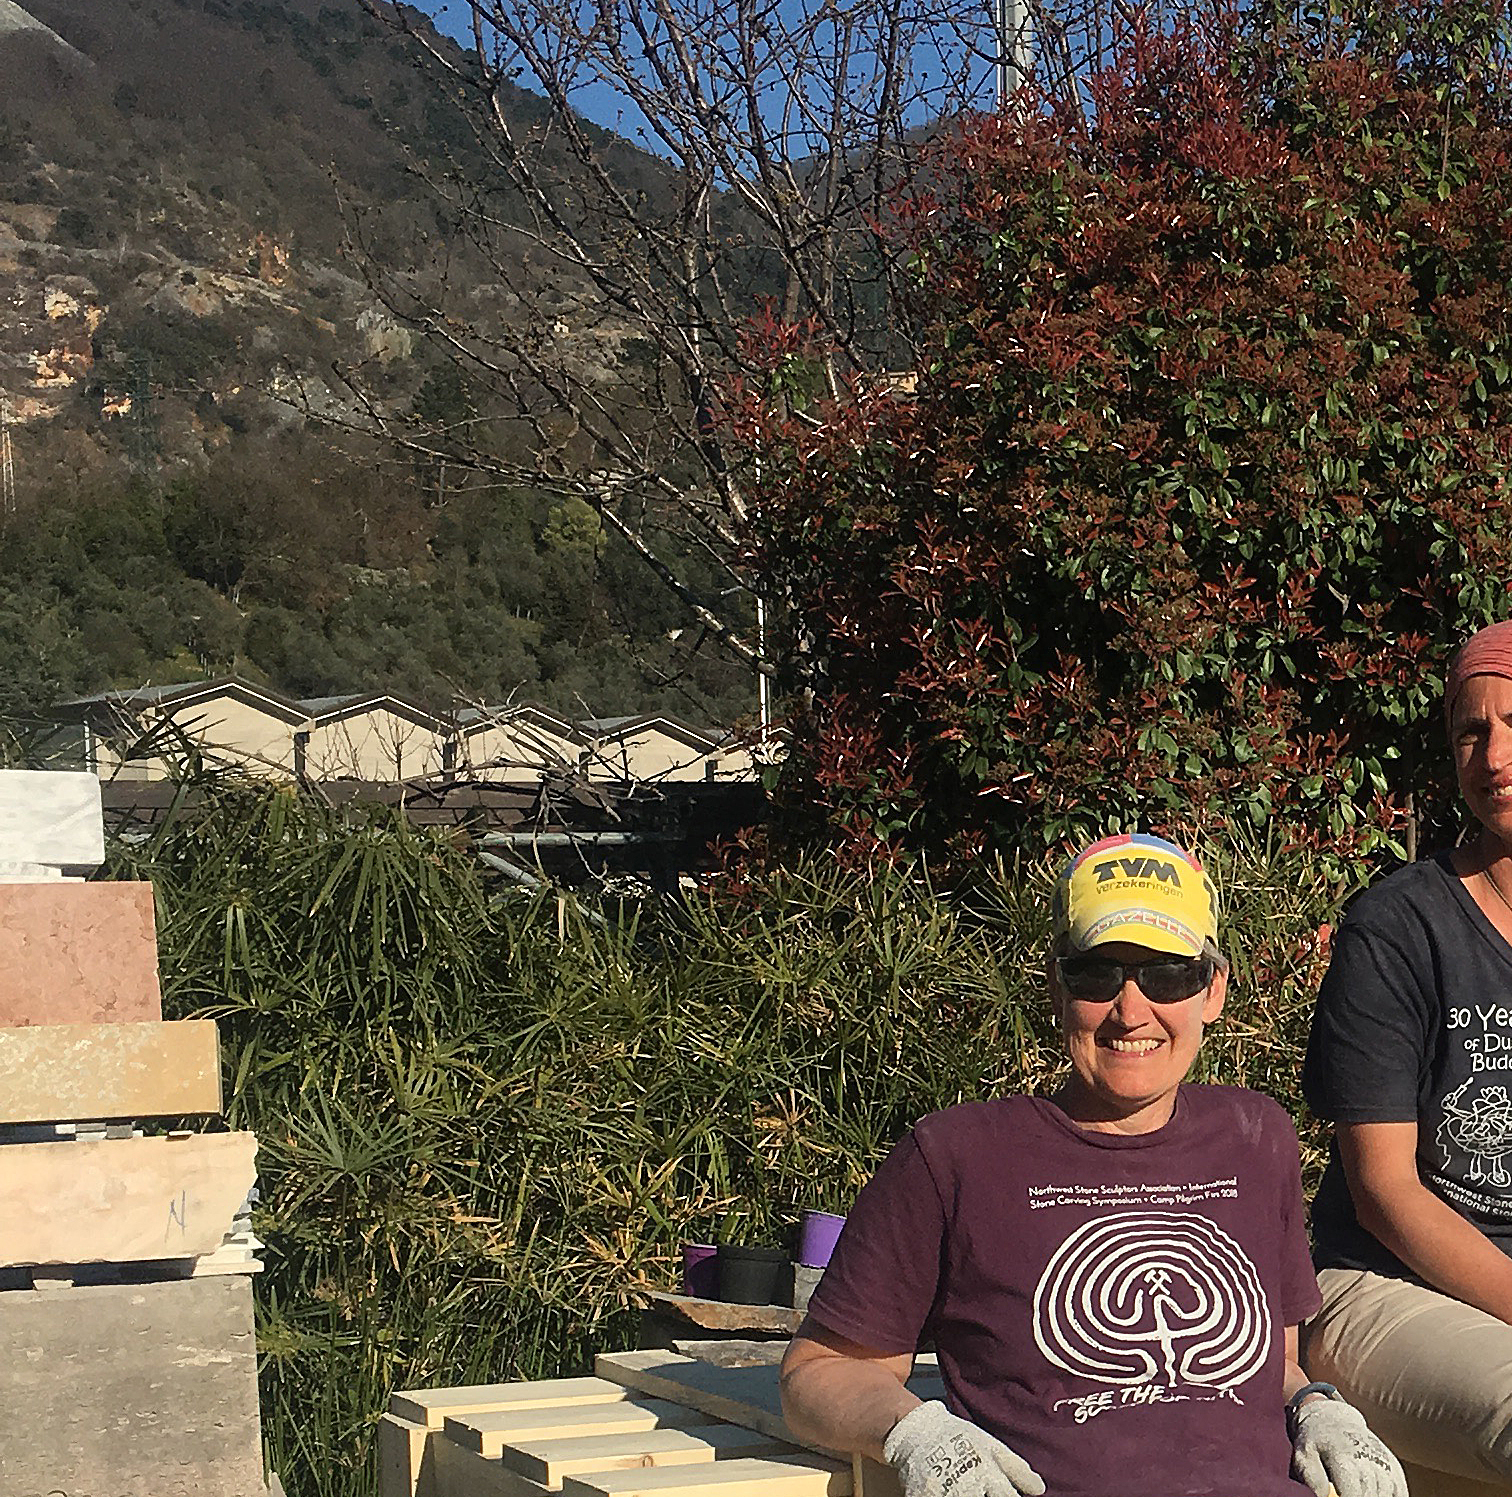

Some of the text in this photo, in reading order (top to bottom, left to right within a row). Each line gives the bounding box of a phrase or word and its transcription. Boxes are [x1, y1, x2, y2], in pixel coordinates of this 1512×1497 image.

[1092, 857, 1182, 888] TVM
[1096, 879, 1184, 899] verzekeringen
[1446, 1007, 1471, 1029] 30
[1463, 1038, 1480, 1051] of
[1074, 1185, 1099, 1194] Stone
[1029, 1199, 1056, 1209] Stone
[1120, 1384, 1165, 1404] THE
